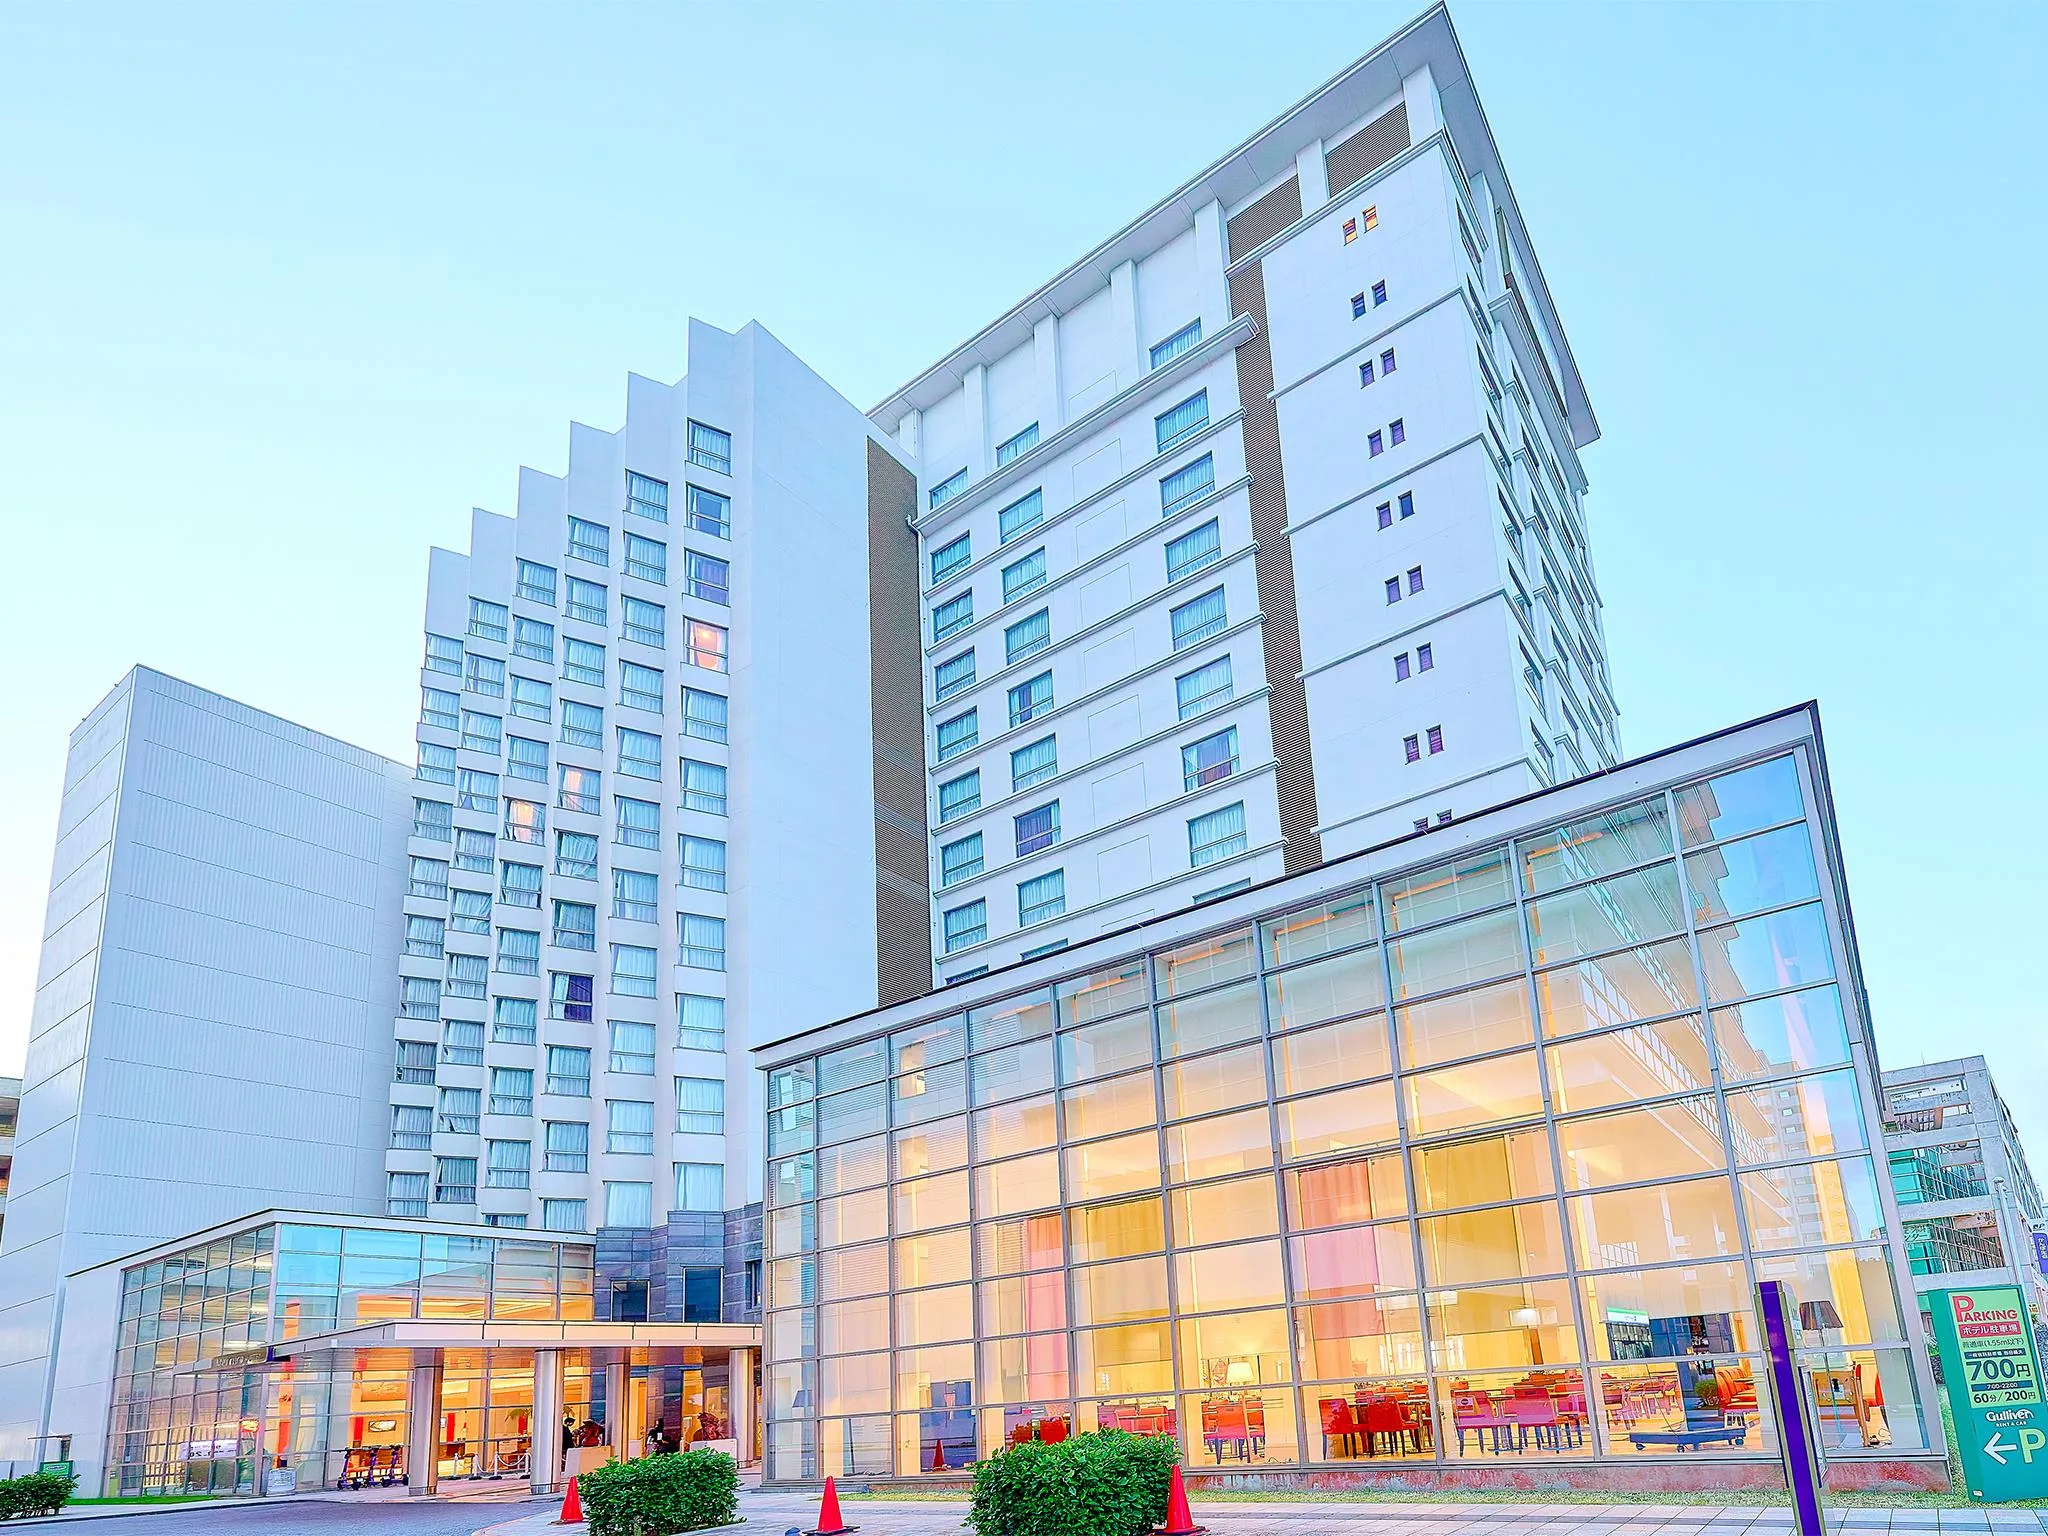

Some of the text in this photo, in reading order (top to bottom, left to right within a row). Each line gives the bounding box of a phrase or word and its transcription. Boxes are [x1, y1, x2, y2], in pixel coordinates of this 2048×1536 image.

[1952, 1295, 2018, 1322] PARKING
[1962, 1324, 2018, 1335] ホテル駐車場
[1966, 1358, 2031, 1381] 700円
[1985, 1408, 2035, 1422] Gulliver
[2018, 1428, 2046, 1464] P
